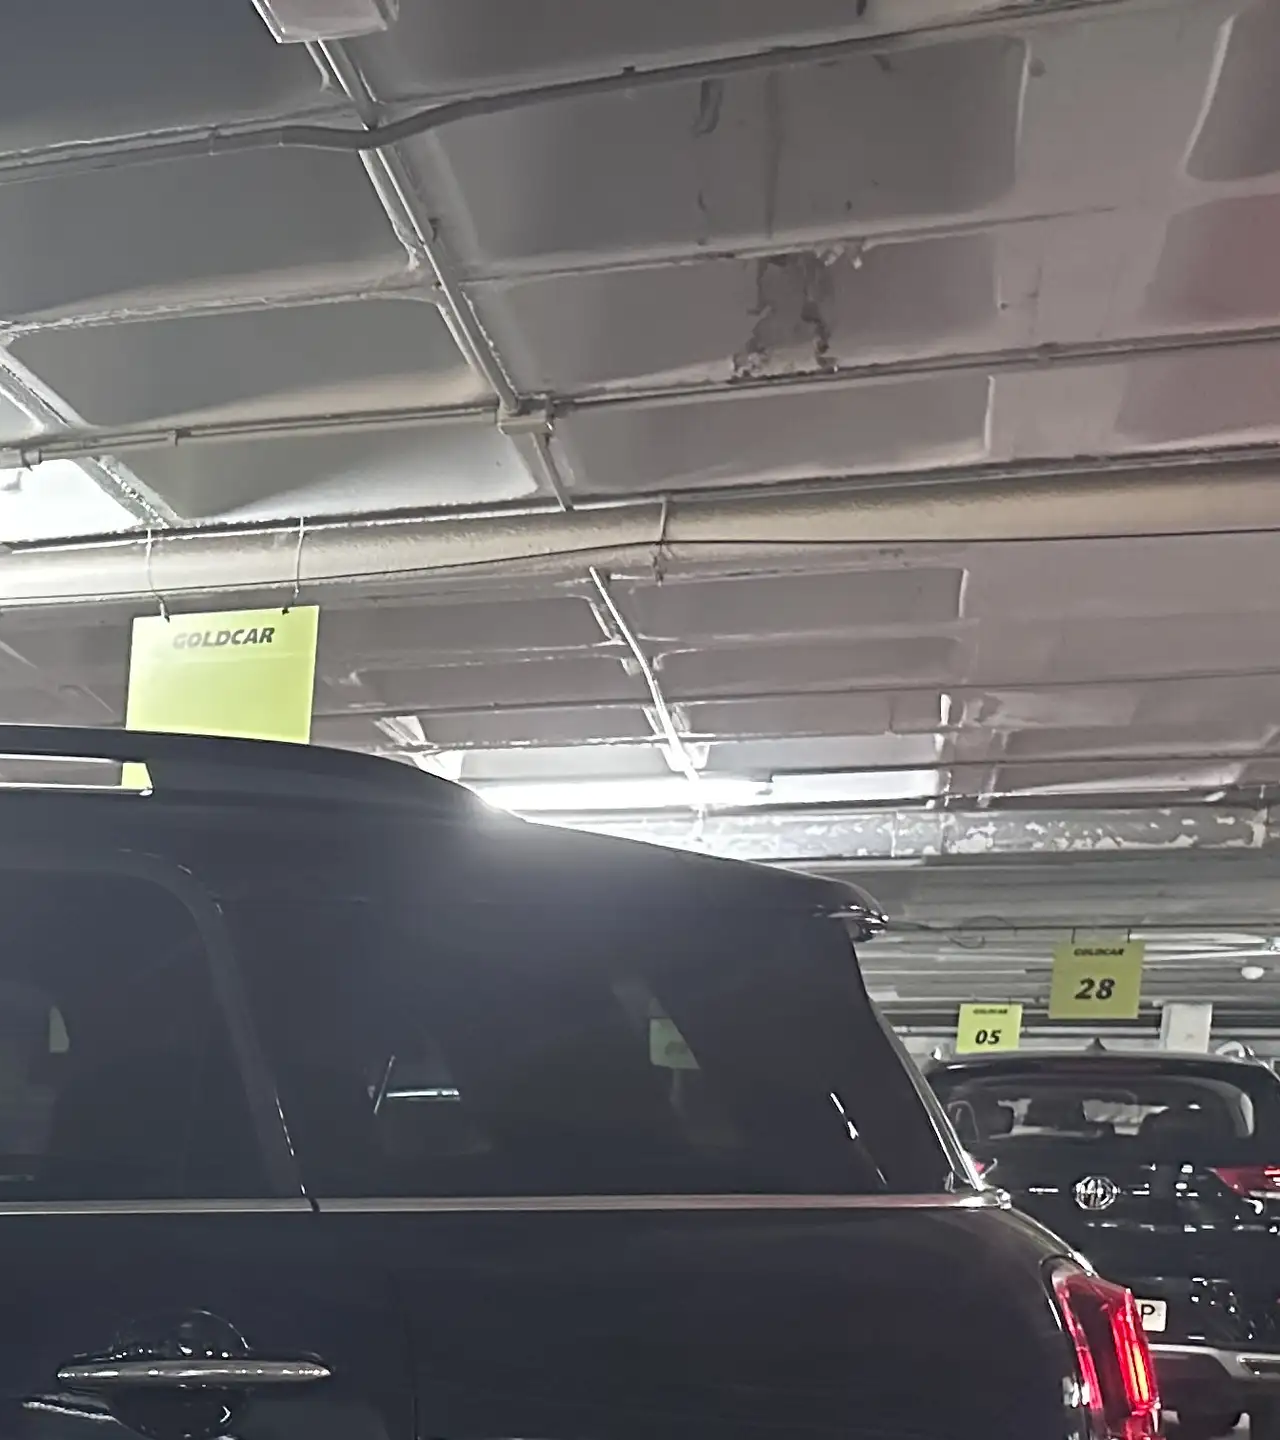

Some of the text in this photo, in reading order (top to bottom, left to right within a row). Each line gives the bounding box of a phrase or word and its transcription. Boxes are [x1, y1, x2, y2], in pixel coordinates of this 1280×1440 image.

[172, 627, 275, 650] GOLDCAR
[1074, 978, 1116, 1000] 28
[975, 1029, 1001, 1045] 05
